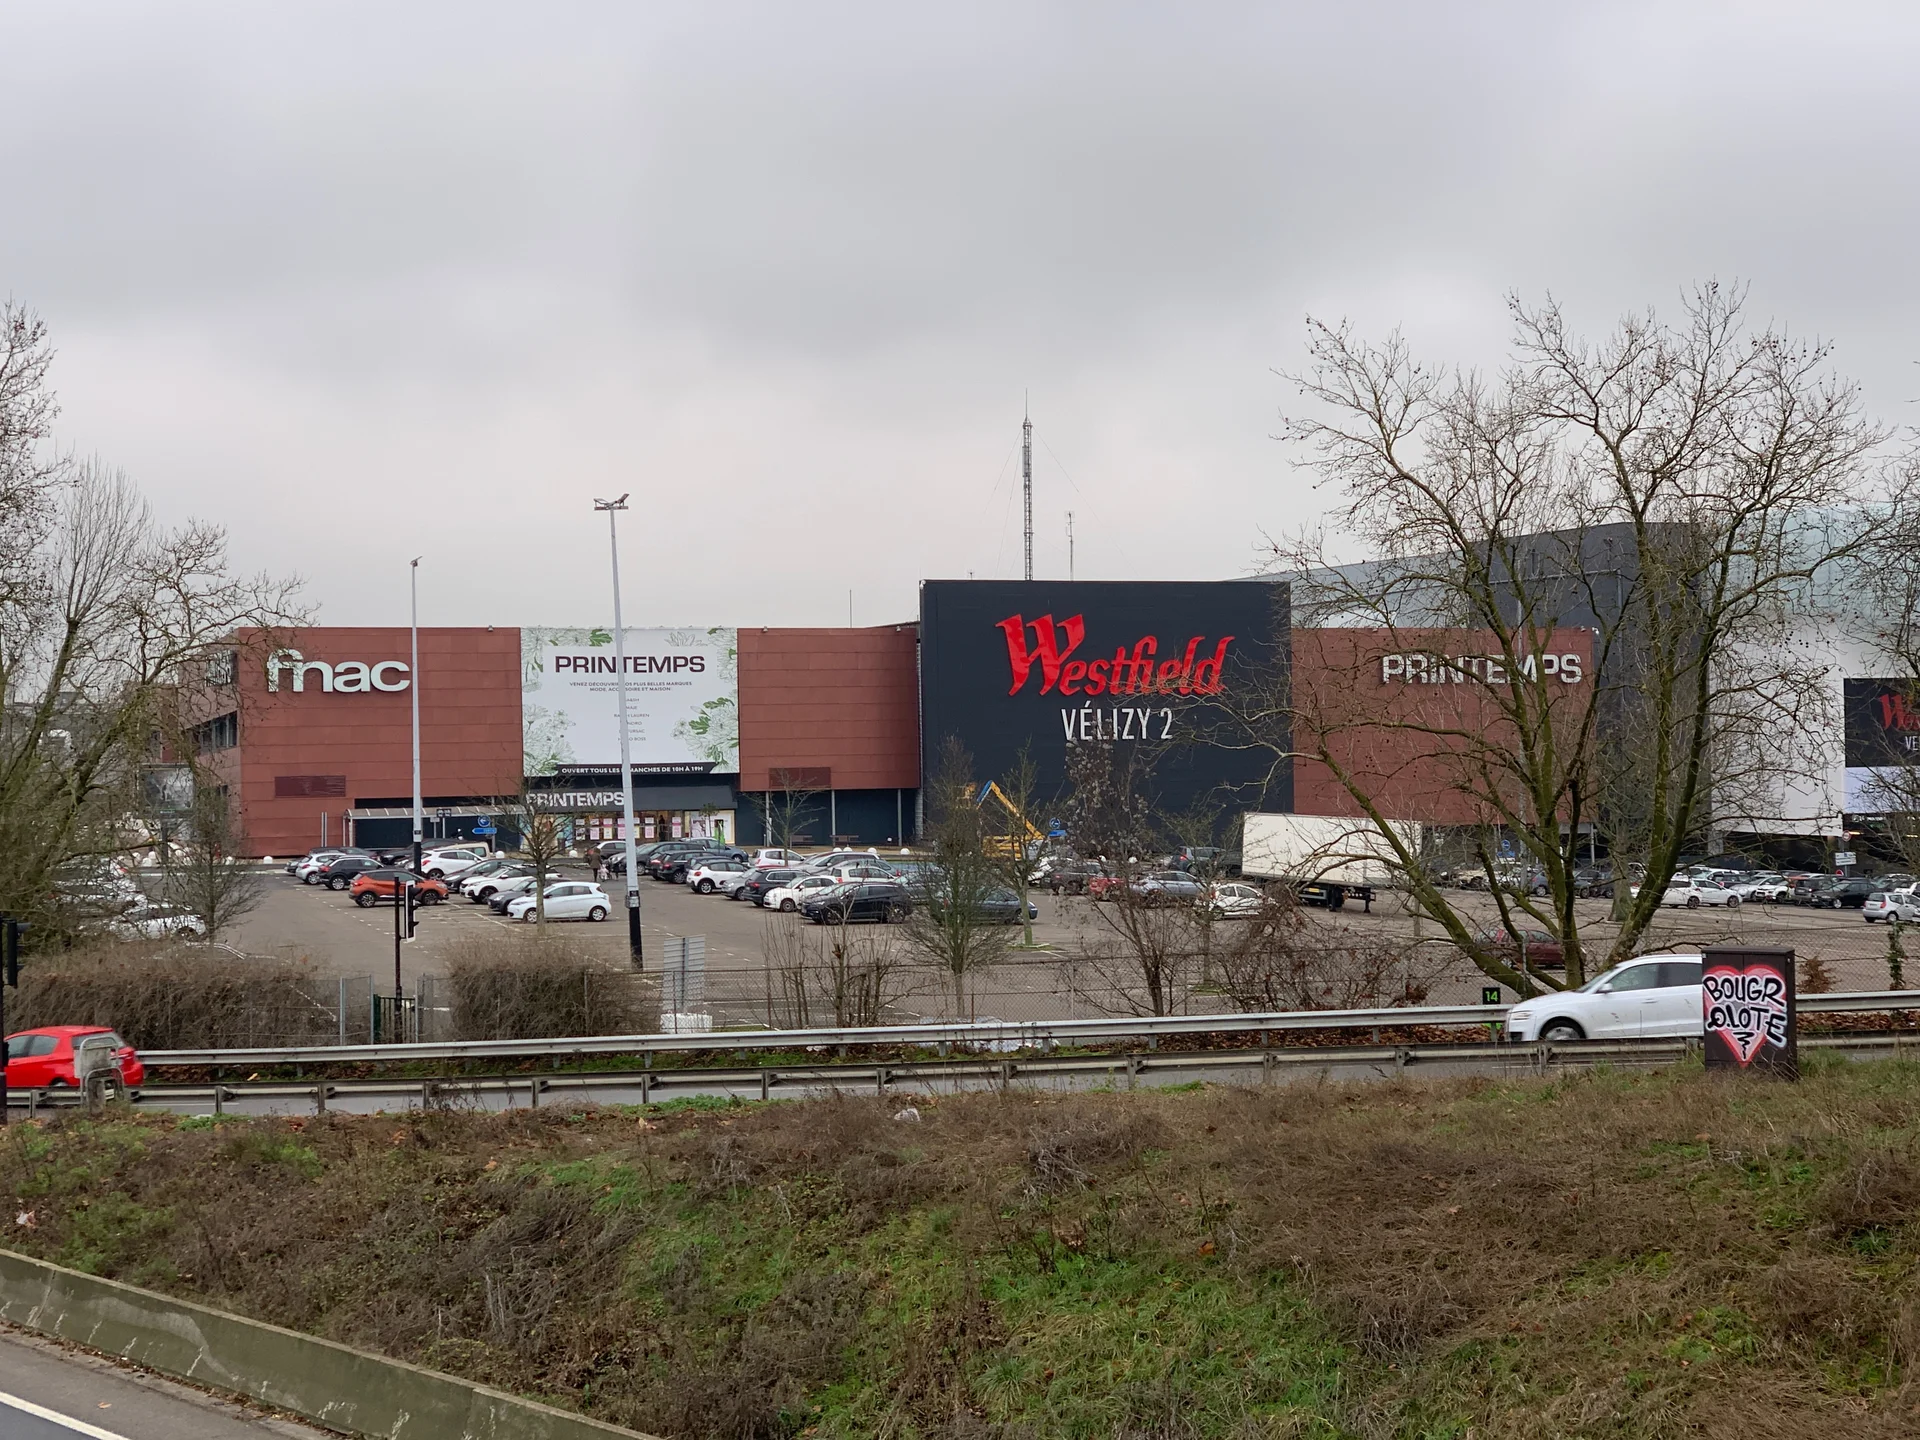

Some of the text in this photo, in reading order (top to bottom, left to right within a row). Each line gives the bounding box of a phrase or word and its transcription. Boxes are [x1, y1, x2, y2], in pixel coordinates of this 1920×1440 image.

[555, 656, 705, 673] PRINTEMPS
[995, 613, 1236, 697] Westfield
[267, 648, 410, 693] fnac
[1061, 700, 1173, 740] VÉLIZY 2
[525, 792, 625, 807] PRINTEMPS
[1485, 991, 1499, 1002] 14
